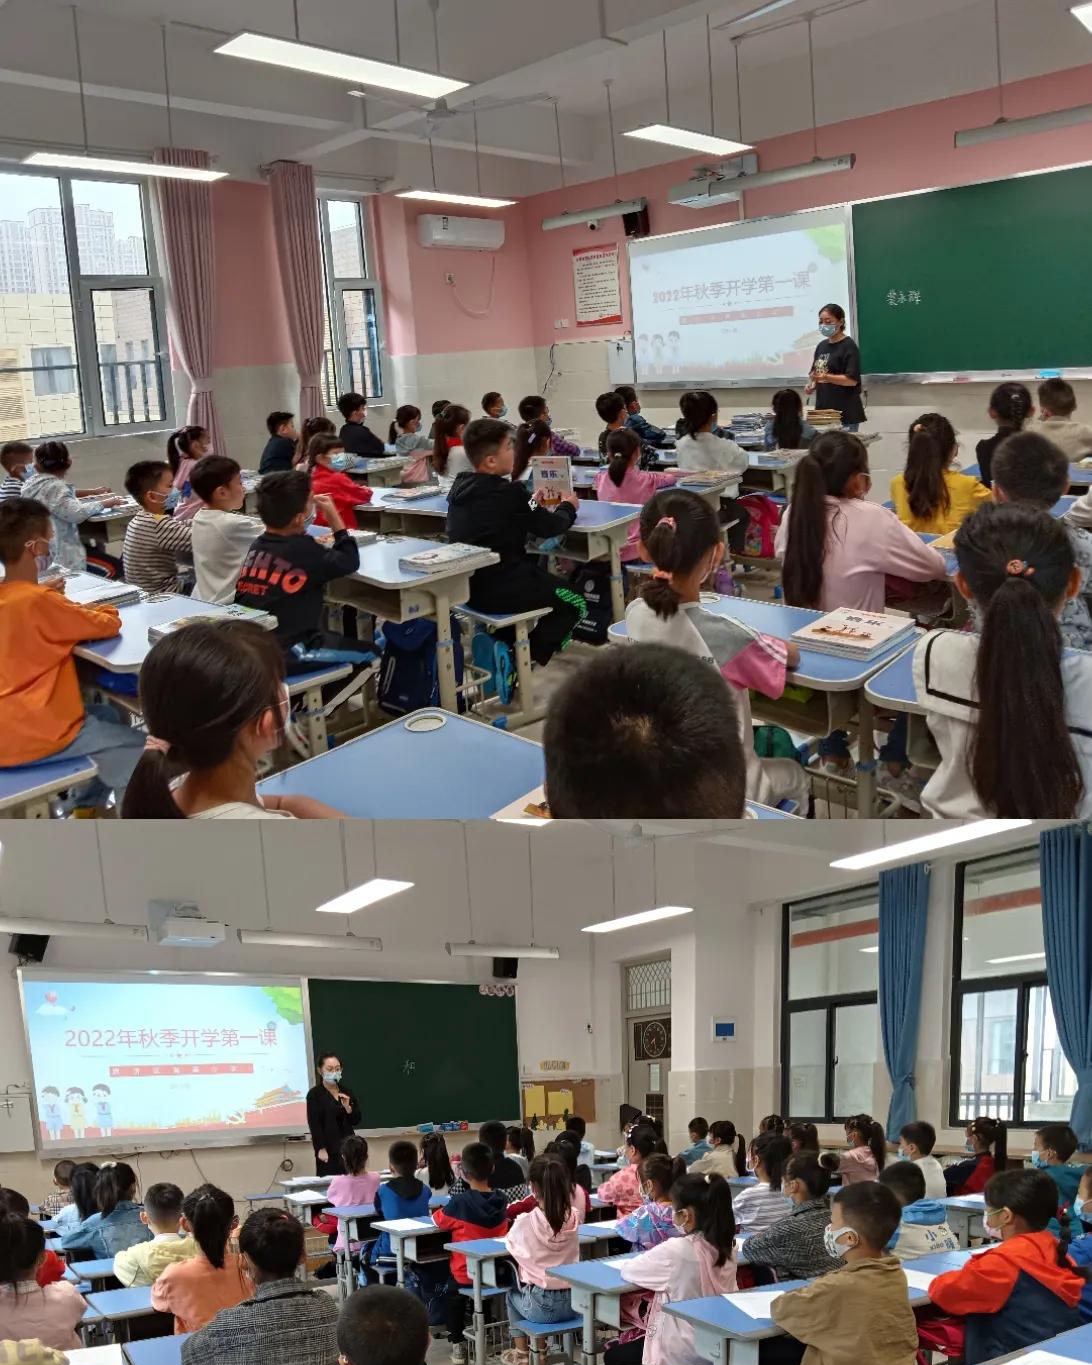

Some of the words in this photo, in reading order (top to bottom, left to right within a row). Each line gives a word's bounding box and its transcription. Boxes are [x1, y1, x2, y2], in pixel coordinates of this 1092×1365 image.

[653, 271, 811, 304] 2022年秋季开学第一课
[64, 1028, 279, 1049] 2022年秋季开学第一课
